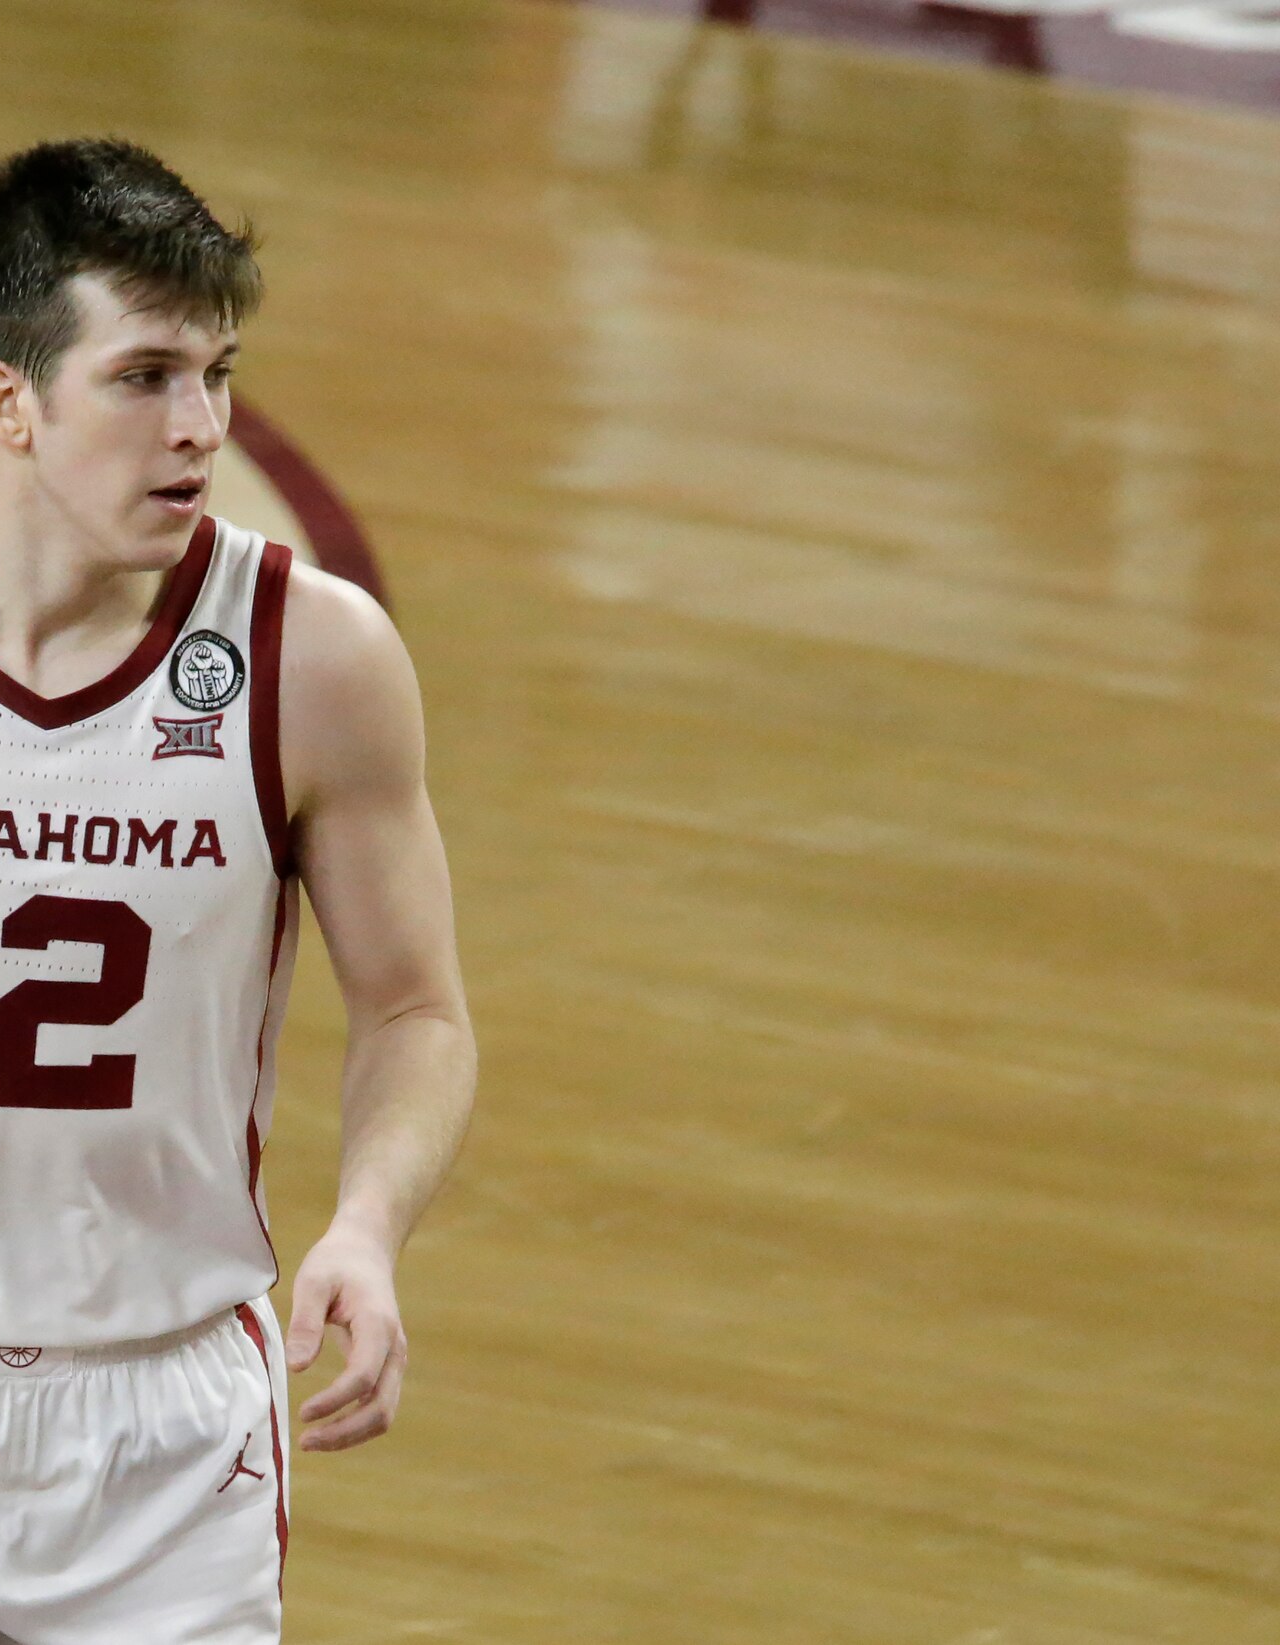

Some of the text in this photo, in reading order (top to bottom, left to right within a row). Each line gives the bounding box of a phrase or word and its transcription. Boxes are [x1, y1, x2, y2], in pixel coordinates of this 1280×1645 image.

[205, 701, 220, 709] FOR
[220, 672, 244, 704] HUMANITY
[157, 718, 219, 754] XII
